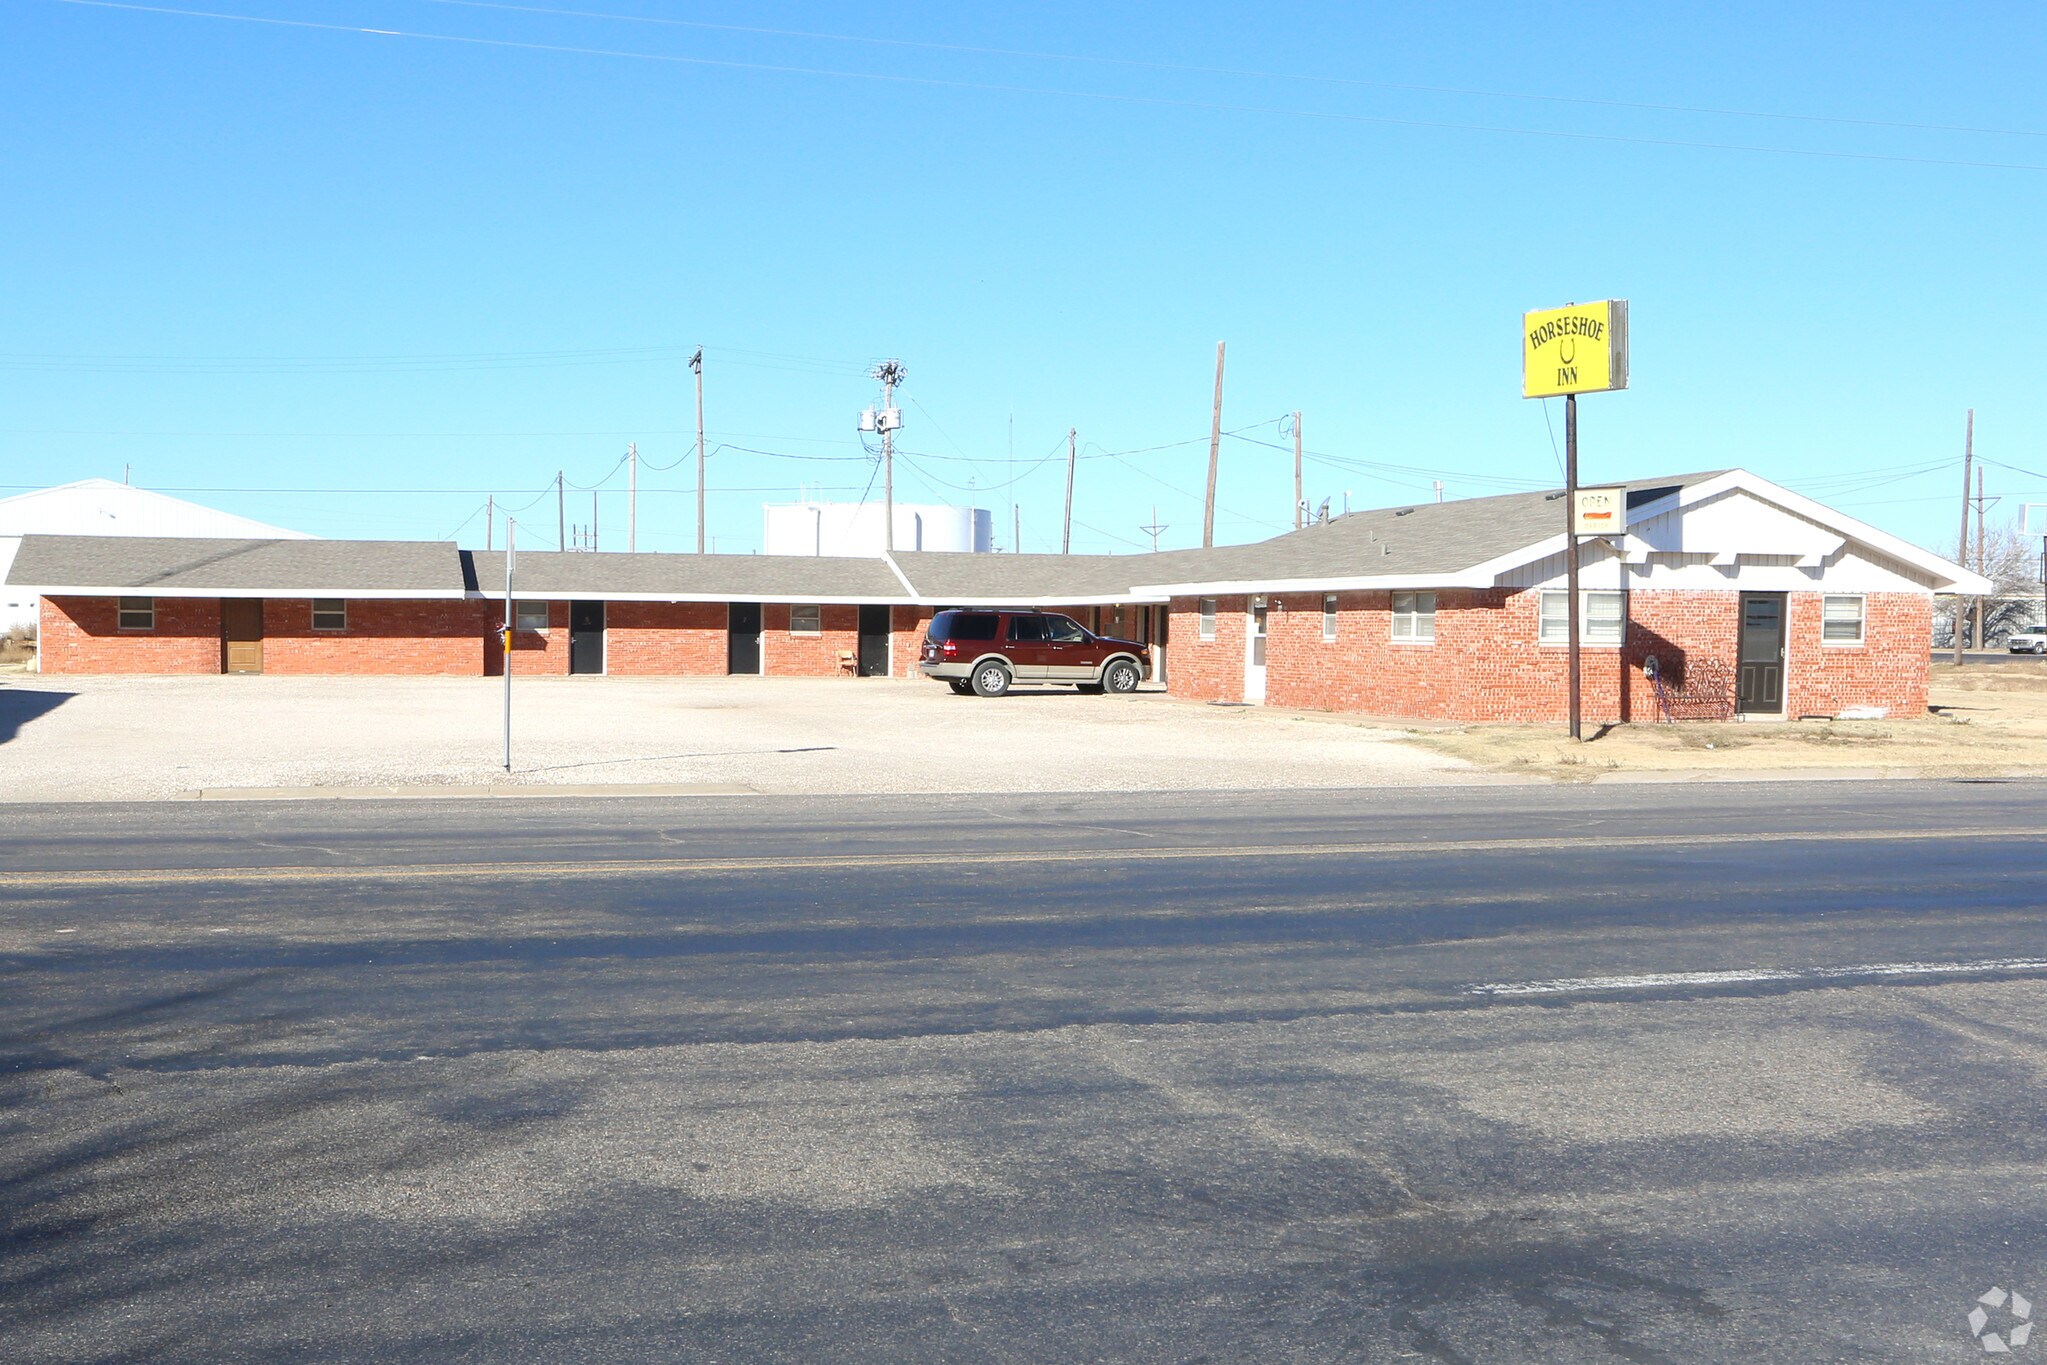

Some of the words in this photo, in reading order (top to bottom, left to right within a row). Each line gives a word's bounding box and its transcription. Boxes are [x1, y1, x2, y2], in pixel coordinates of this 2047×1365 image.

[1529, 316, 1605, 350] HORSESHOE
[1557, 366, 1578, 387] INN
[1581, 495, 1611, 508] OPEN
